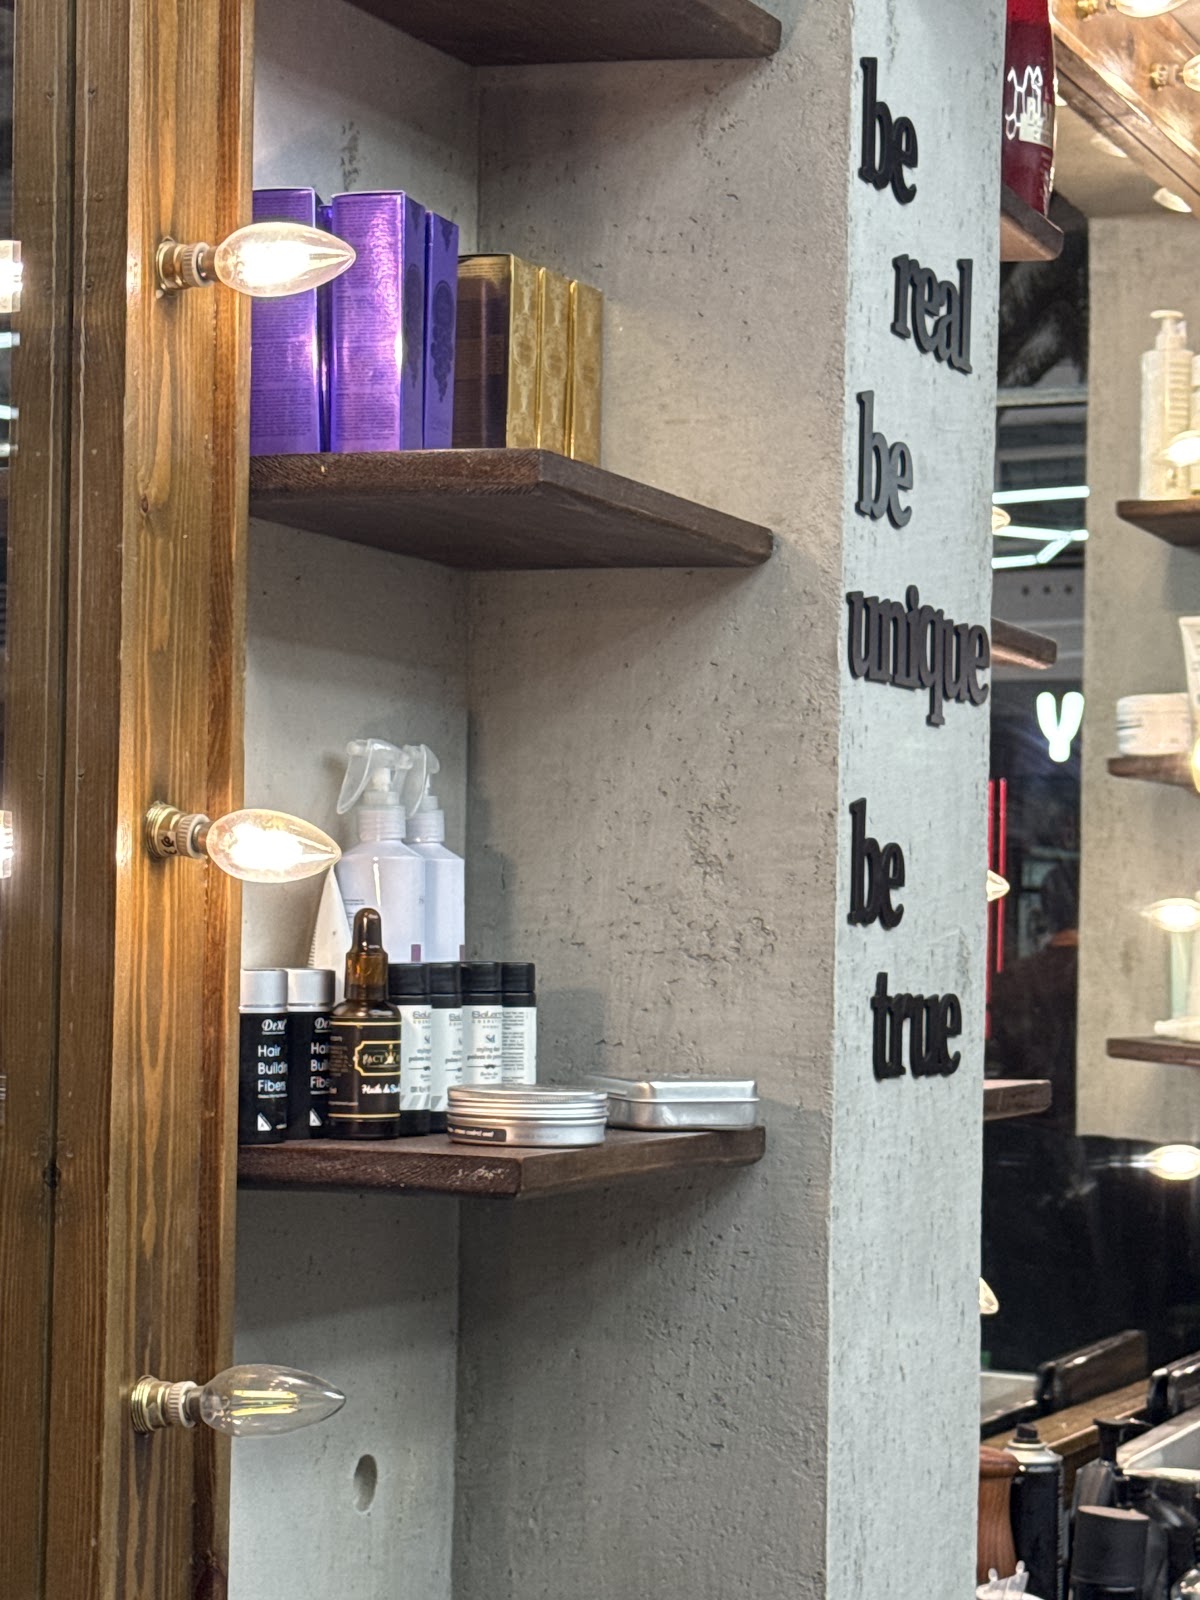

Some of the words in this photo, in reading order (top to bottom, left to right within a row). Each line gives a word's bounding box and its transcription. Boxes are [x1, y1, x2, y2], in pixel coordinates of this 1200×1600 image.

[858, 56, 918, 204] be
[891, 254, 973, 374] real
[855, 390, 913, 528] be
[846, 585, 990, 727] unique
[847, 797, 905, 931] be
[258, 1044, 281, 1057] Hair
[870, 972, 962, 1082] true
